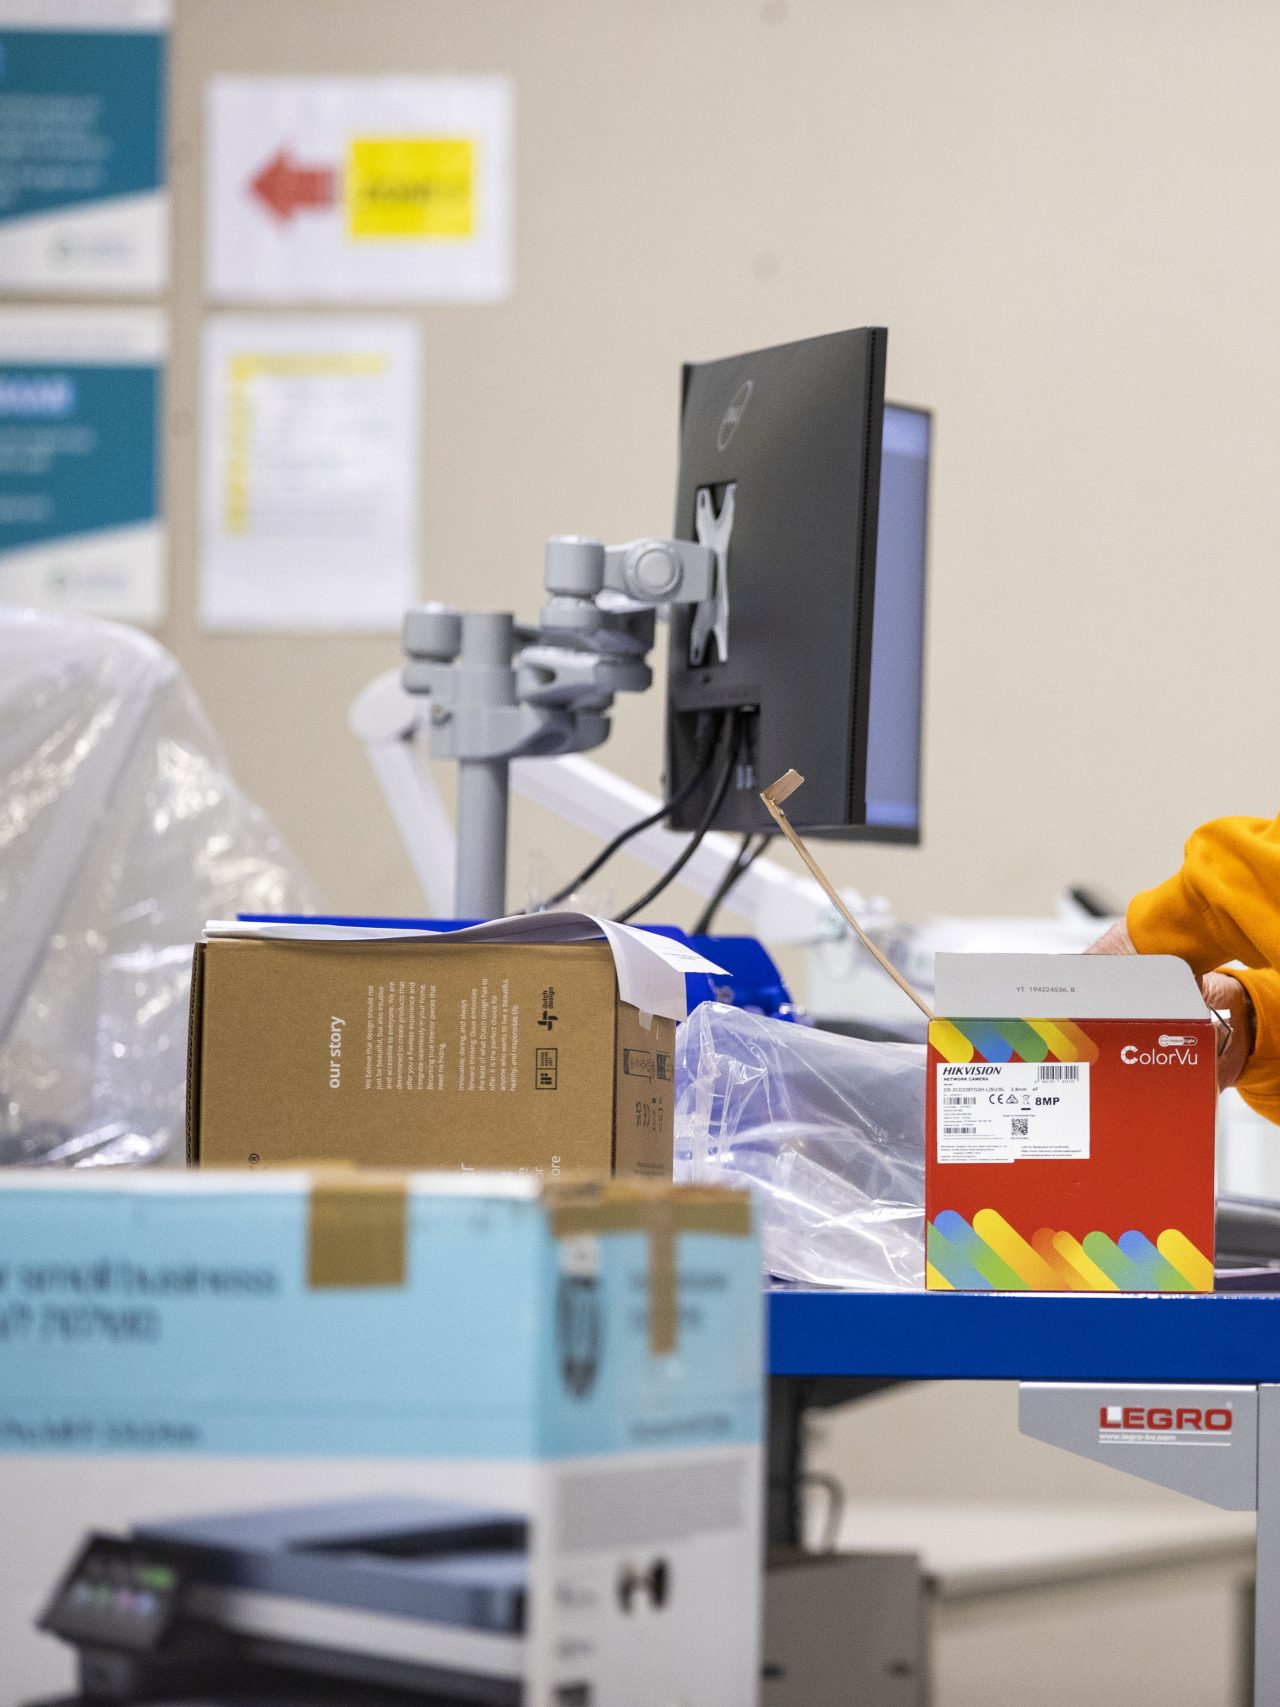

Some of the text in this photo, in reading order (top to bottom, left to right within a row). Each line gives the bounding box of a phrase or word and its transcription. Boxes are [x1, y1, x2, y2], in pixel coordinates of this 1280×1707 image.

[329, 1016, 346, 1088] our story
[1120, 1045, 1198, 1065] ColorVu
[943, 1066, 1002, 1075] HIKVISION
[1035, 1097, 1060, 1106] 8MP
[1100, 1406, 1232, 1431] LEGRO
[1099, 1432, 1176, 1441] www.legro-bv.com
